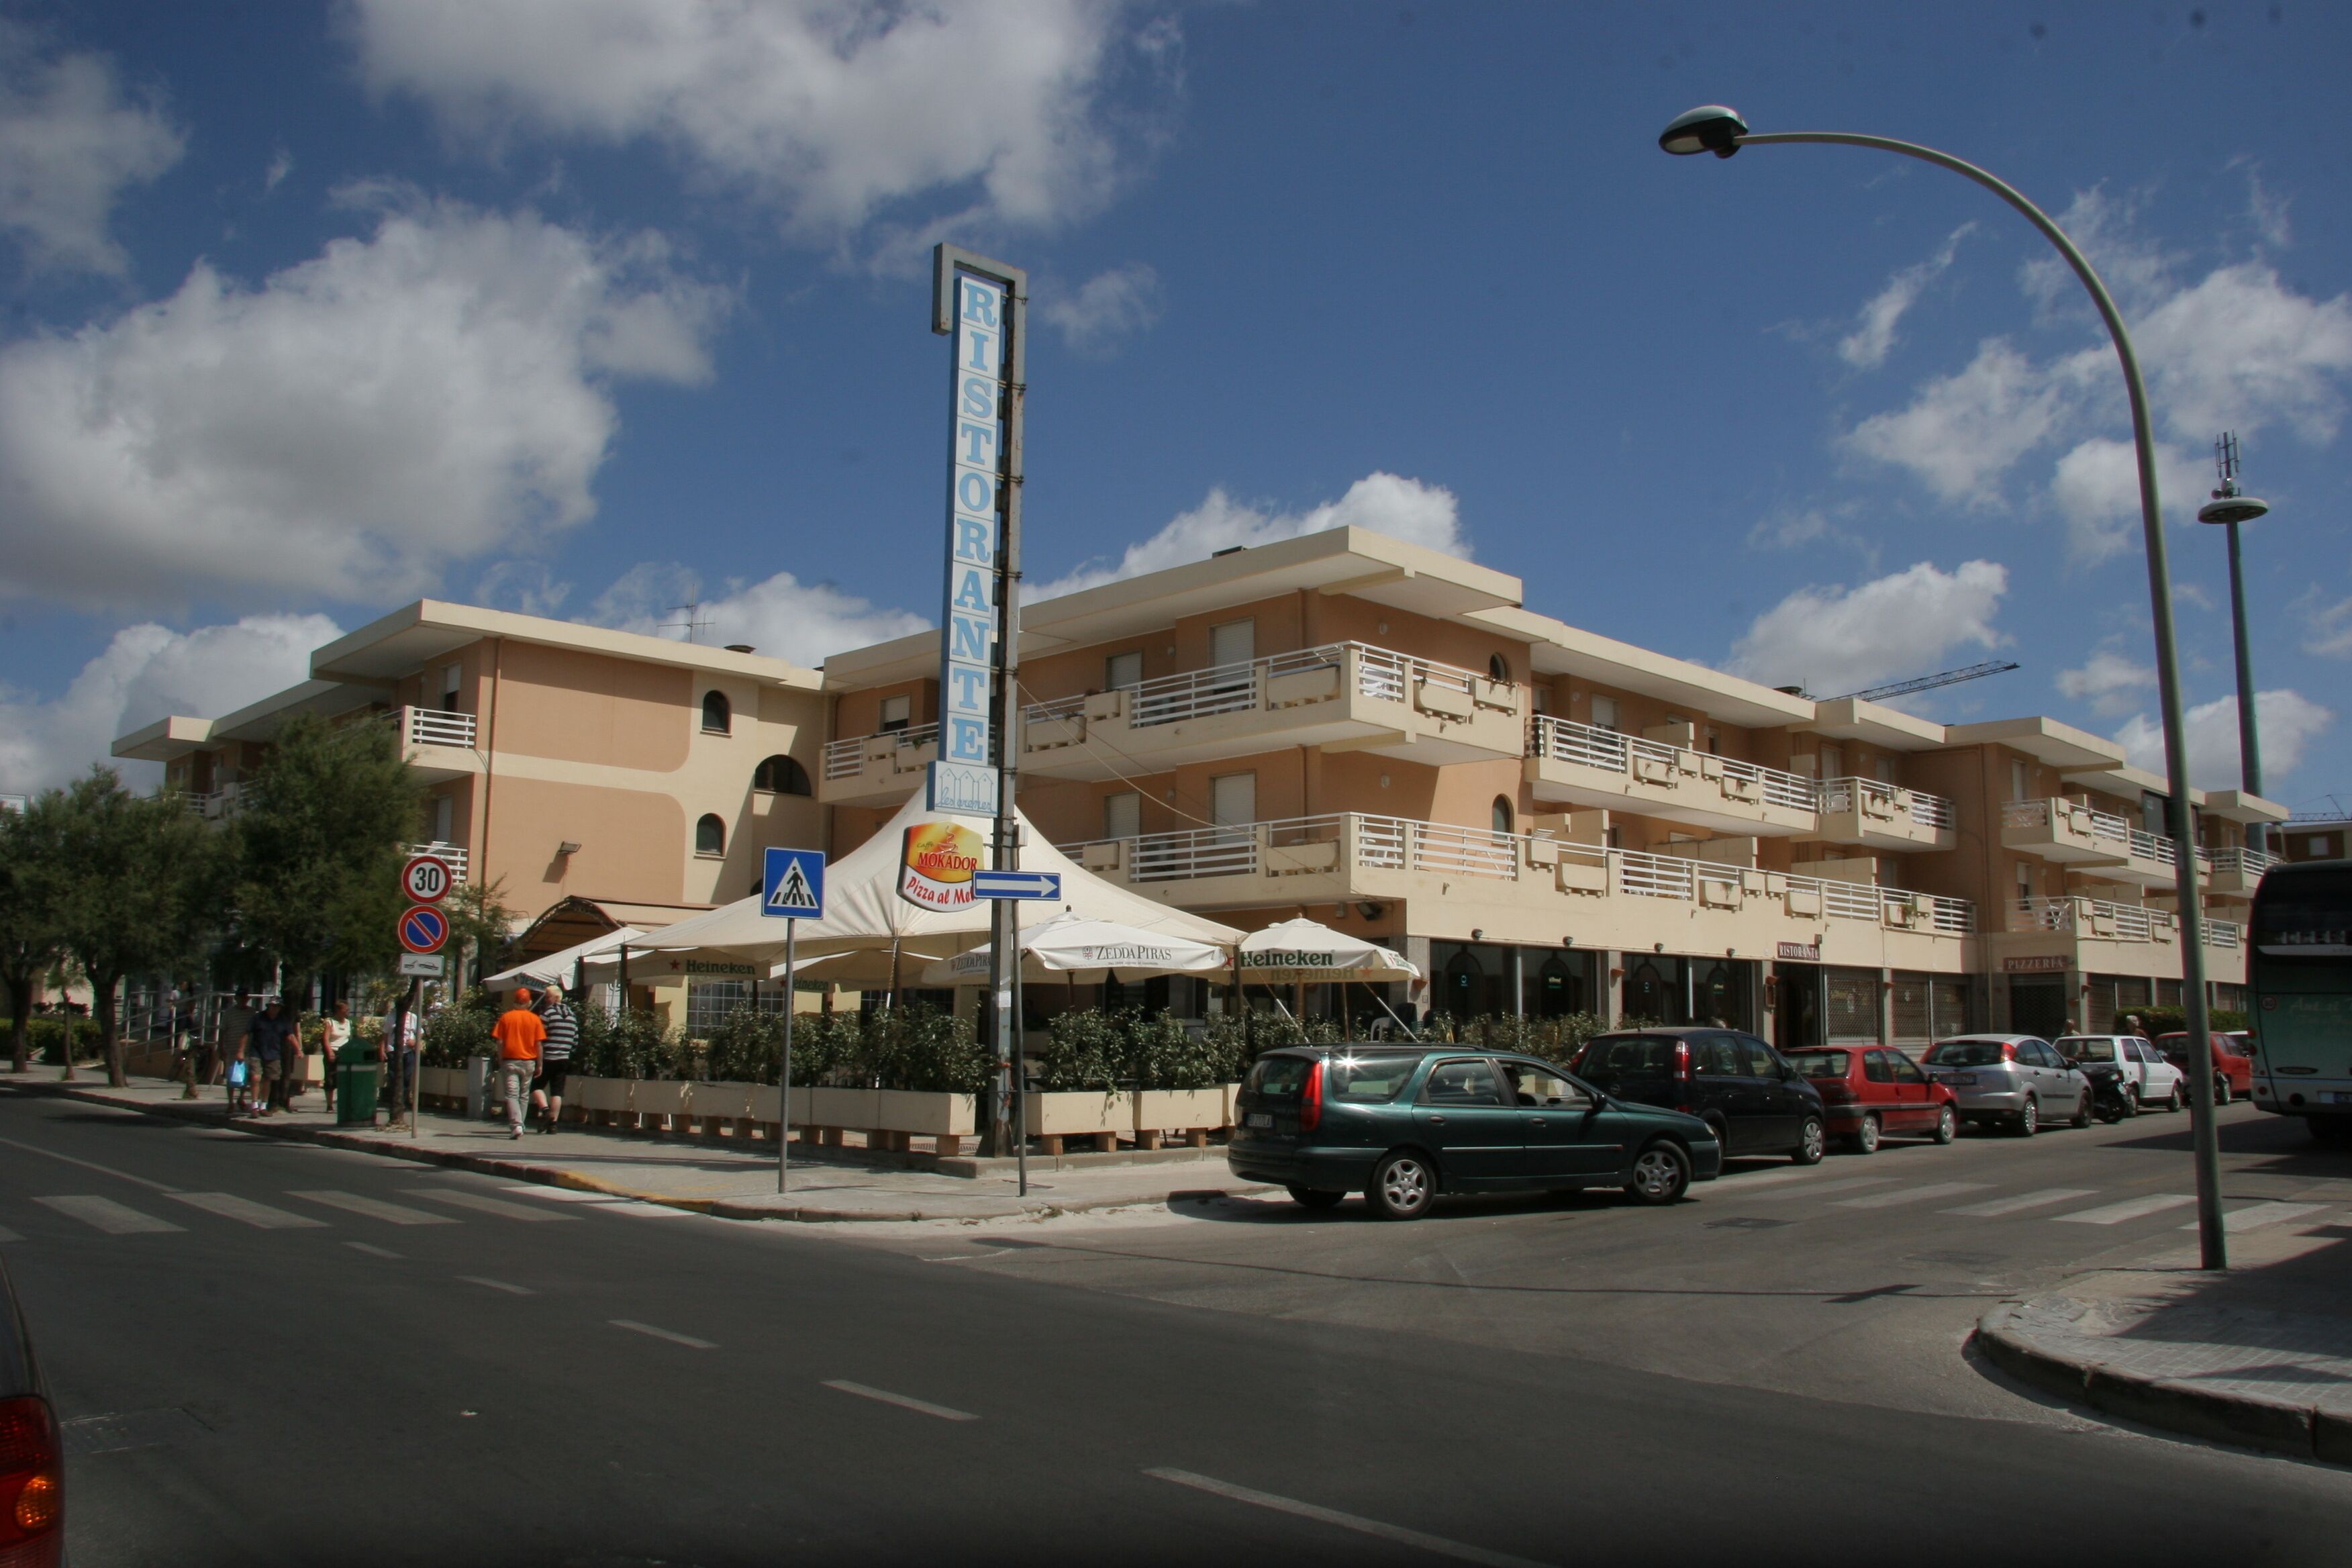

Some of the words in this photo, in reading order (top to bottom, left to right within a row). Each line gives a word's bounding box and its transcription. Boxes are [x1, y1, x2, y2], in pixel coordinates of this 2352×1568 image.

[950, 283, 998, 762] RISTORANTE
[918, 852, 977, 871] MOKADOR
[415, 867, 440, 891] 30
[906, 876, 935, 901] Pizza
[937, 889, 950, 904] al
[1095, 946, 1135, 960] ZEDDA
[1137, 945, 1172, 961] PIRAS
[1240, 950, 1333, 967] Heineken
[1779, 944, 1818, 959] RISTORANTE
[685, 959, 756, 975] Heineken
[975, 953, 991, 967] PIRA
[2008, 958, 2063, 969] PIZZERIA
[793, 977, 829, 991] eineken
